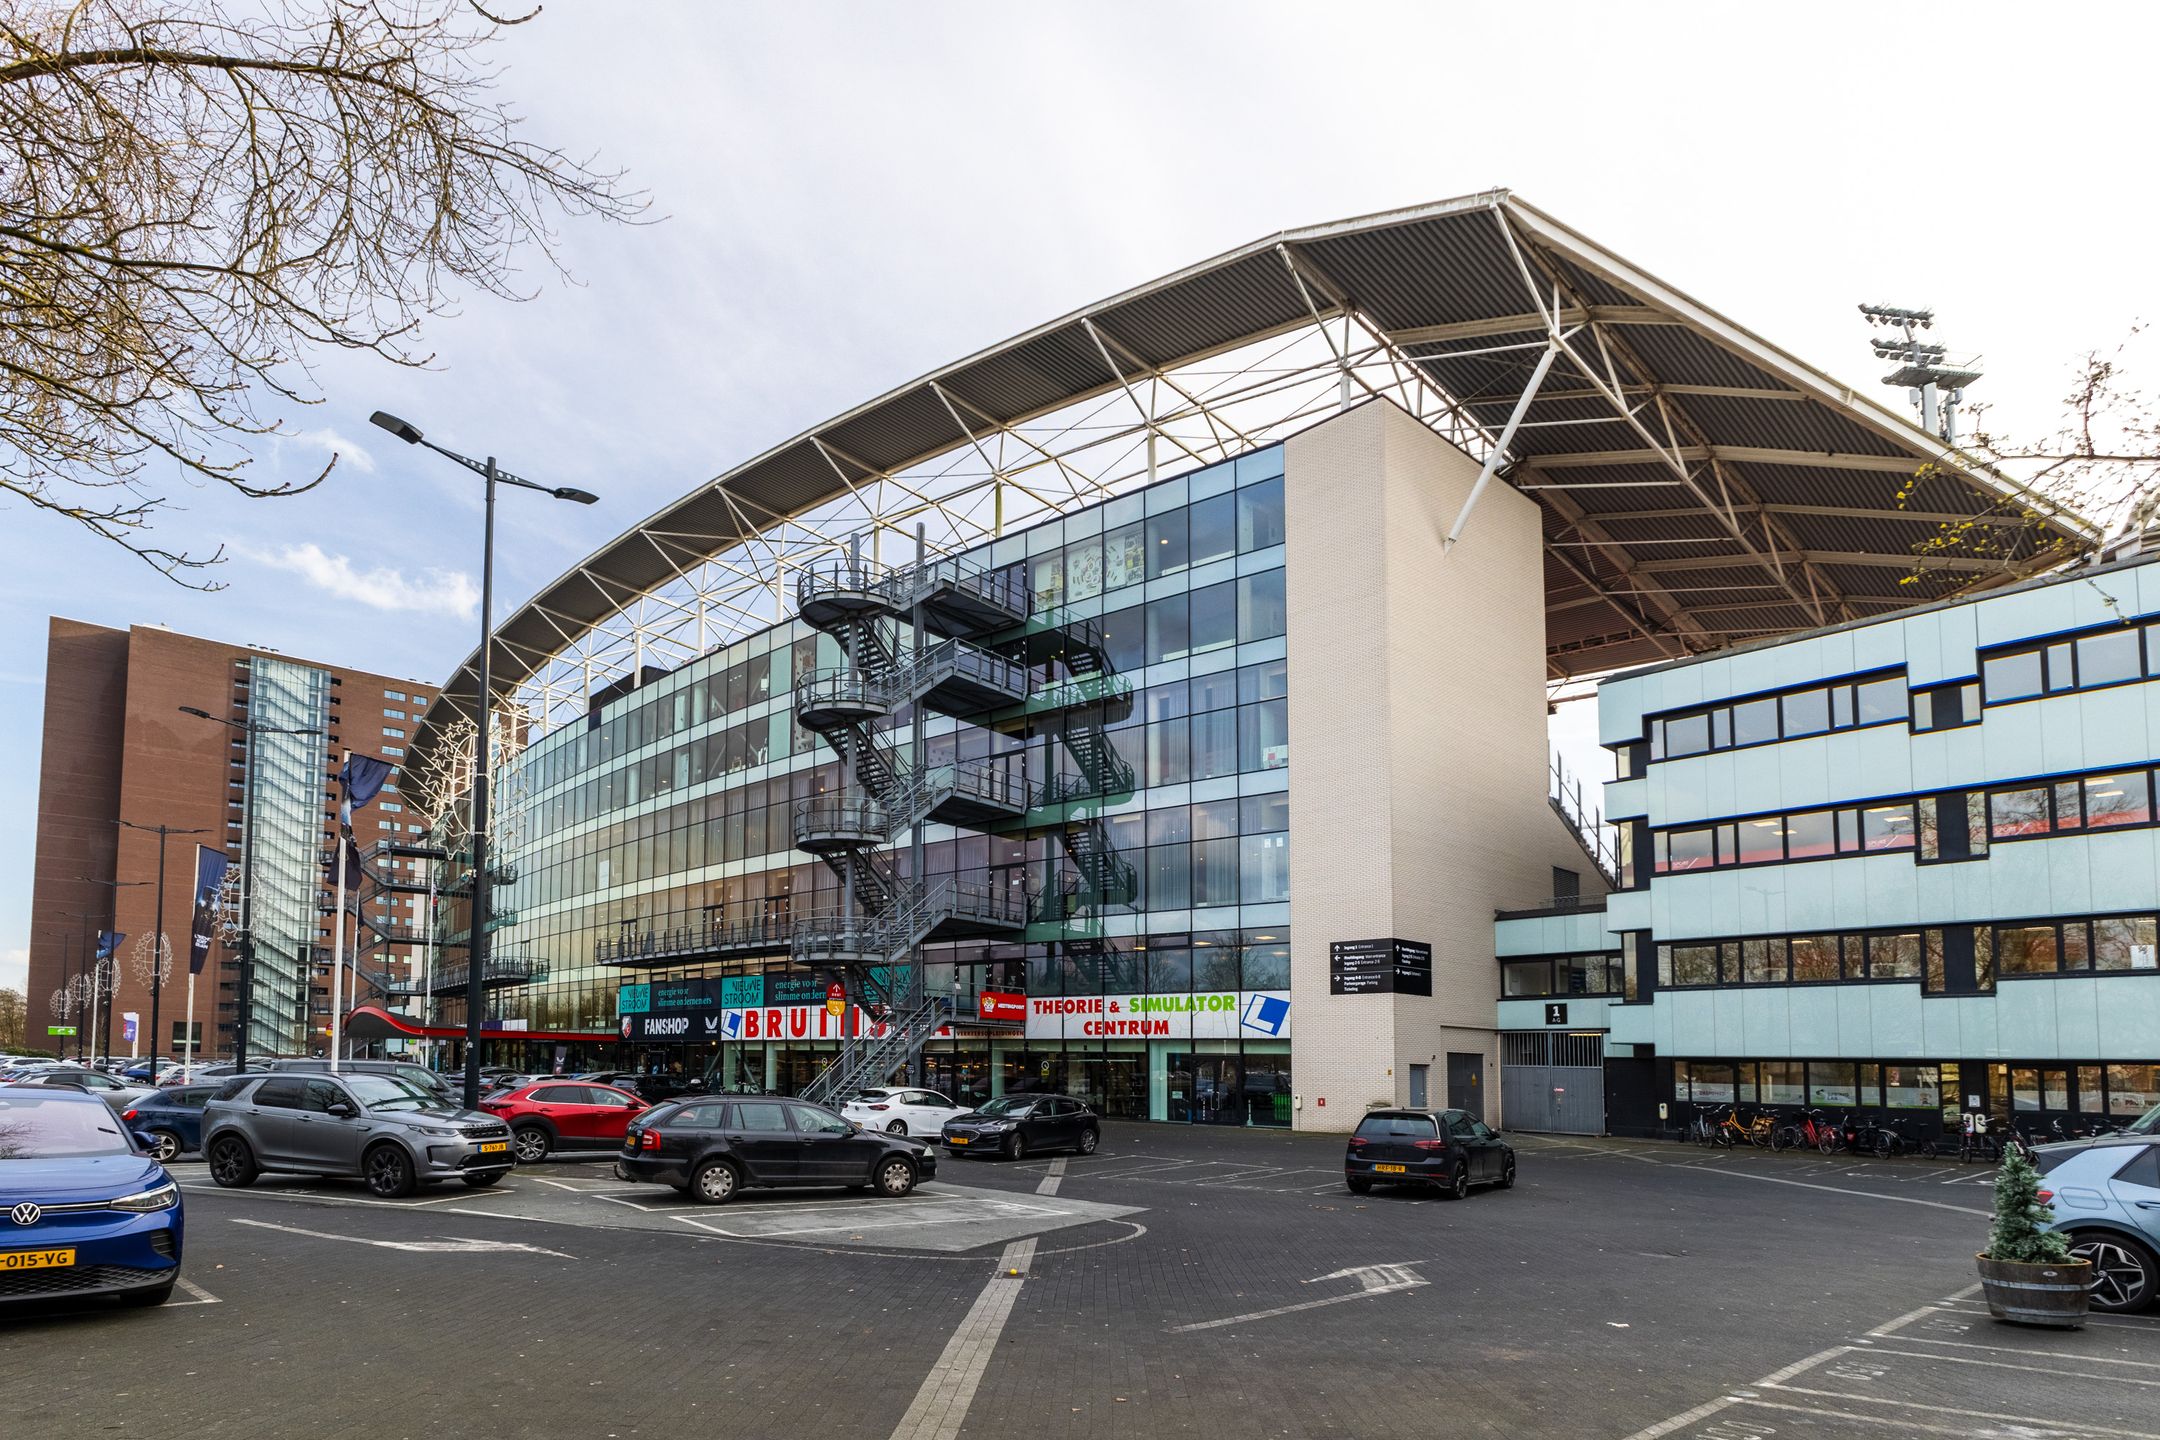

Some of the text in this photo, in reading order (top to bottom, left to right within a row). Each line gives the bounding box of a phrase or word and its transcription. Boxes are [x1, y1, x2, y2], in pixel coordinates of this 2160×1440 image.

[774, 979, 800, 990] energie
[658, 987, 676, 998] energie
[774, 991, 800, 1001] slimme
[724, 992, 760, 1005] STROOM
[622, 1000, 648, 1011] STROOM
[1034, 995, 1236, 1015] THEORIE & SIMULATOR
[1552, 1006, 1560, 1017] 1
[644, 1017, 690, 1035] FANSHOP
[1083, 1020, 1170, 1036] CENTRUM
